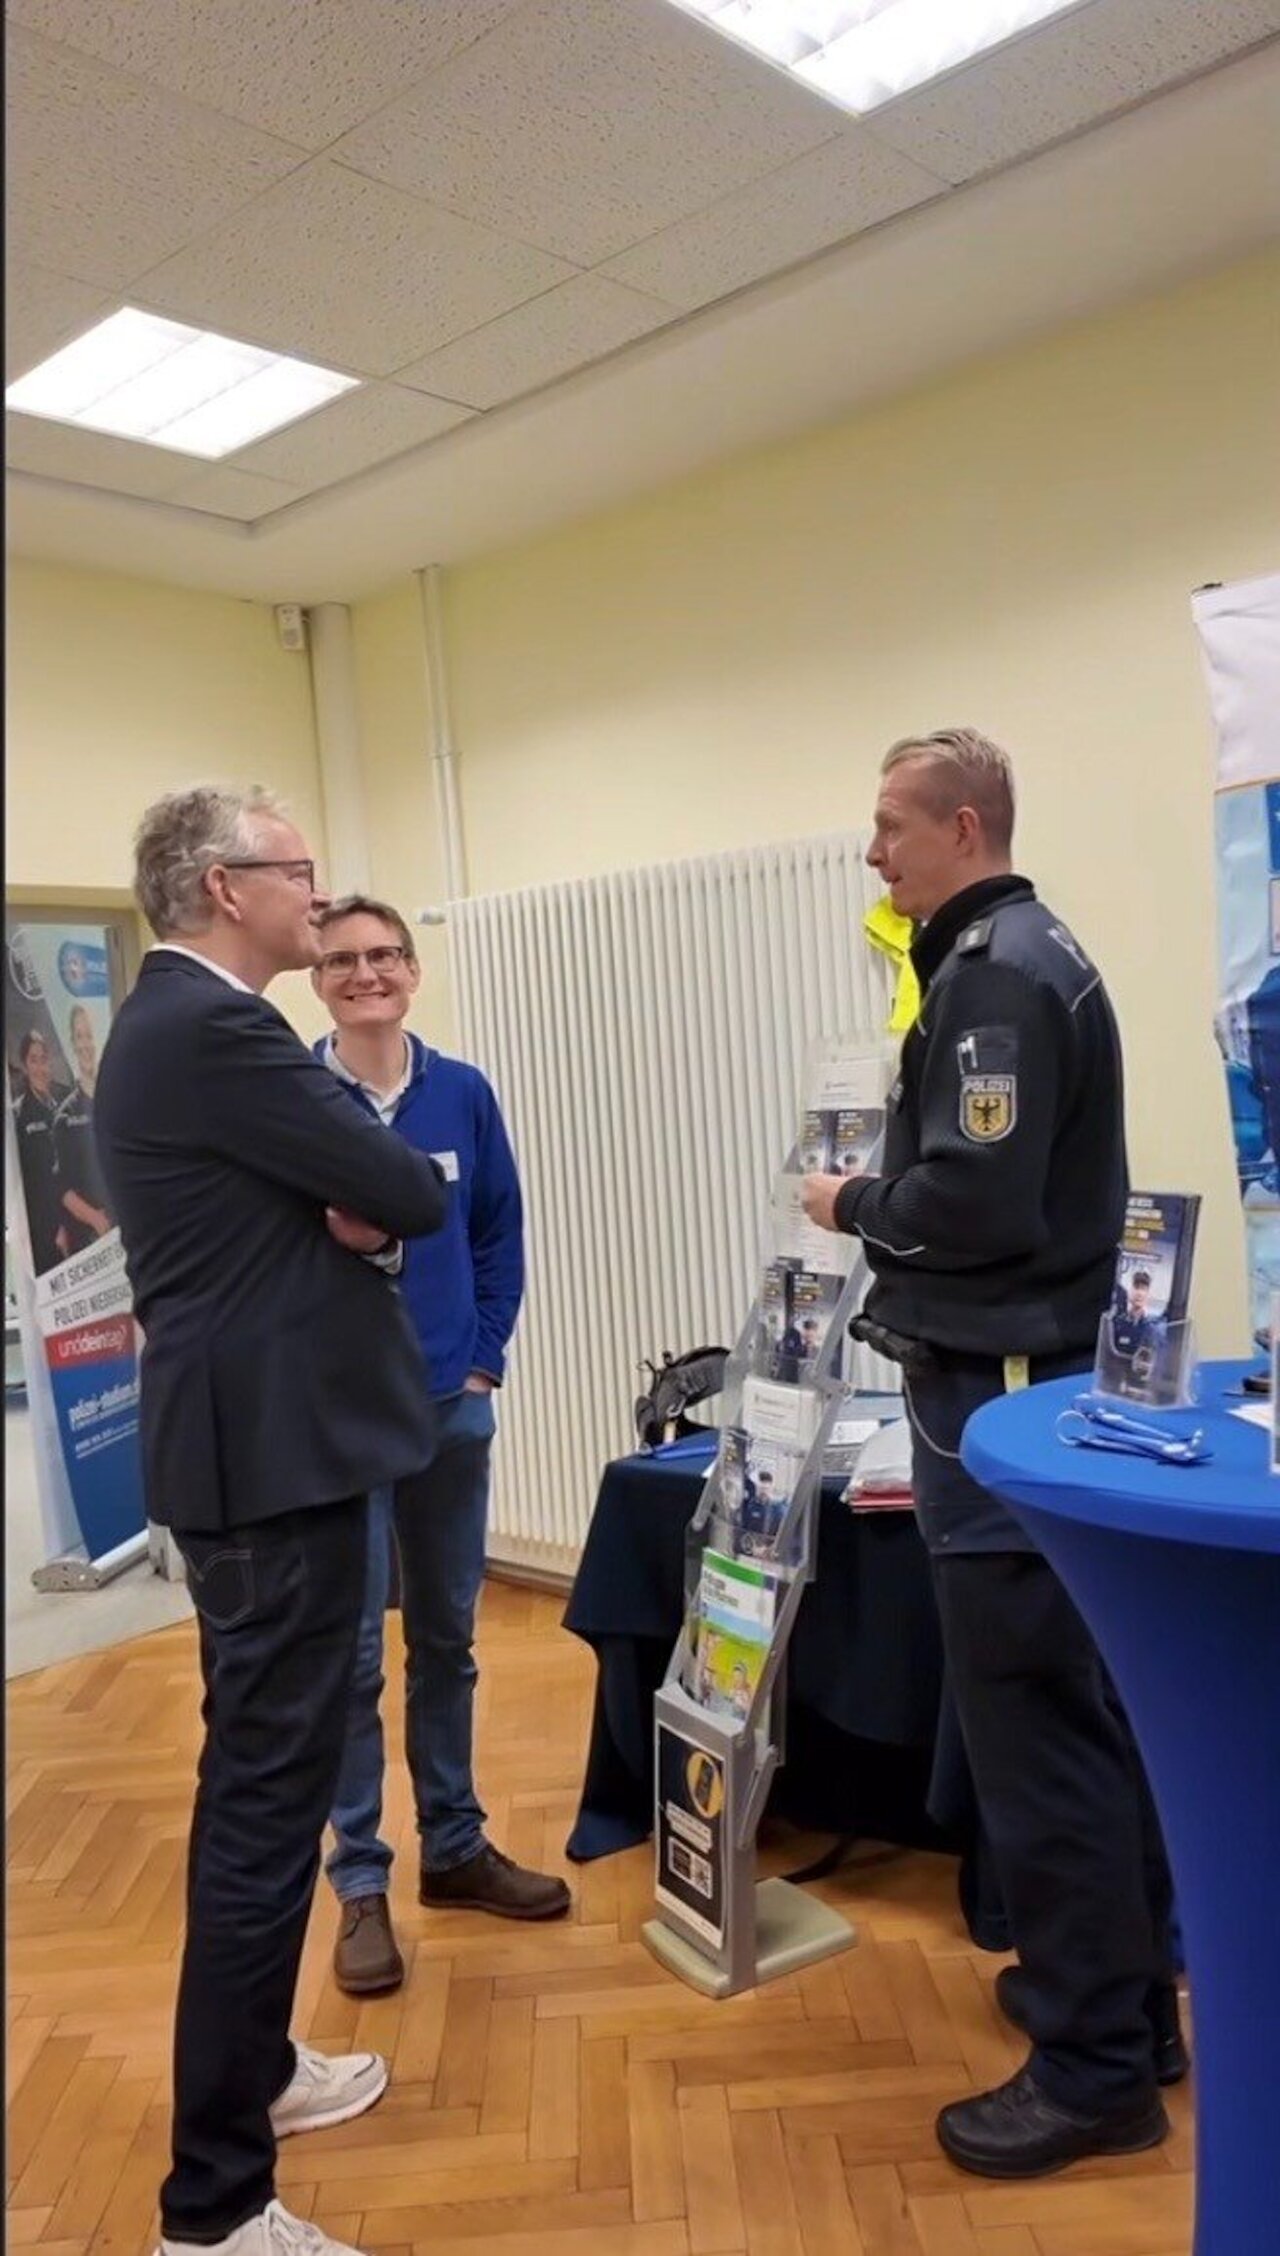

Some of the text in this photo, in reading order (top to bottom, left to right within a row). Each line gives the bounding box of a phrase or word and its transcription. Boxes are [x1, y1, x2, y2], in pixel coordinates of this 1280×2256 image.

[962, 1079, 1011, 1093] POLIZEI
[49, 1272, 68, 1297] MIT
[53, 1296, 88, 1327] POLIZEI
